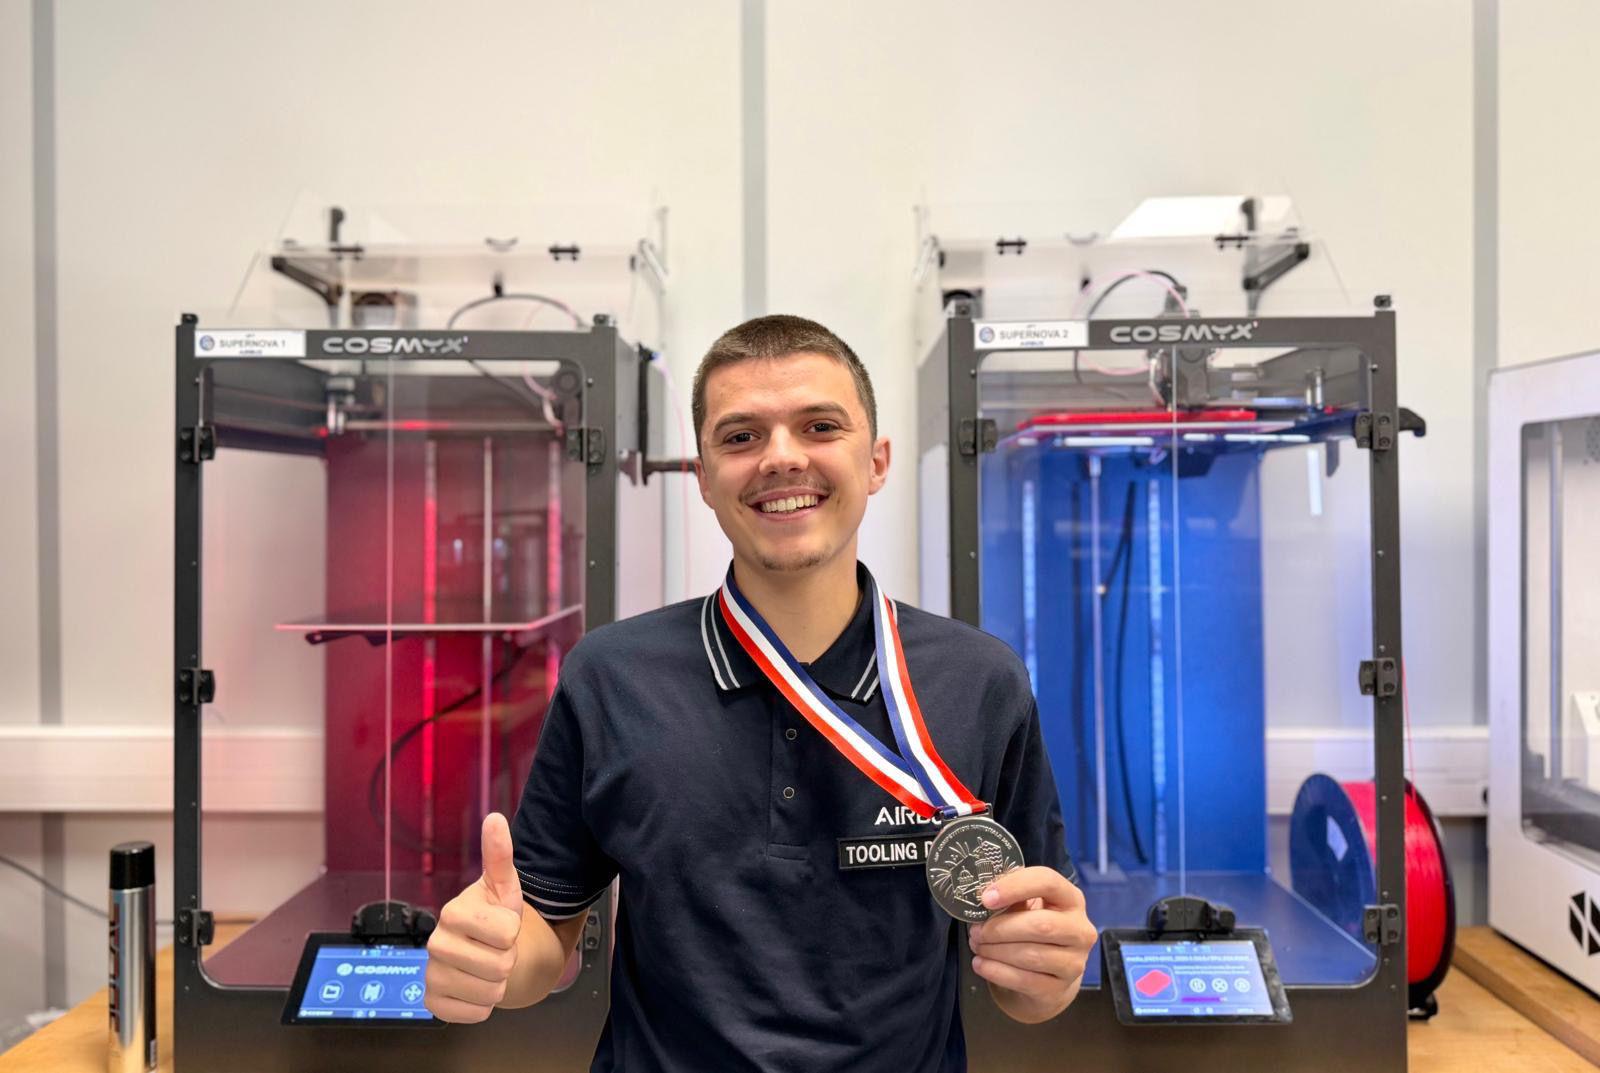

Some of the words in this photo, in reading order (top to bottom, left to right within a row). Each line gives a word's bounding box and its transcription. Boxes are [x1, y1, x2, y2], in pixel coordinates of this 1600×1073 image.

[999, 329, 1060, 340] SUPERNOVA
[1062, 329, 1069, 339] 2
[1110, 324, 1253, 343] COSMYX
[219, 338, 278, 349] SUPERNOVA
[322, 337, 464, 354] COSMYX
[845, 842, 918, 865] TOOLING
